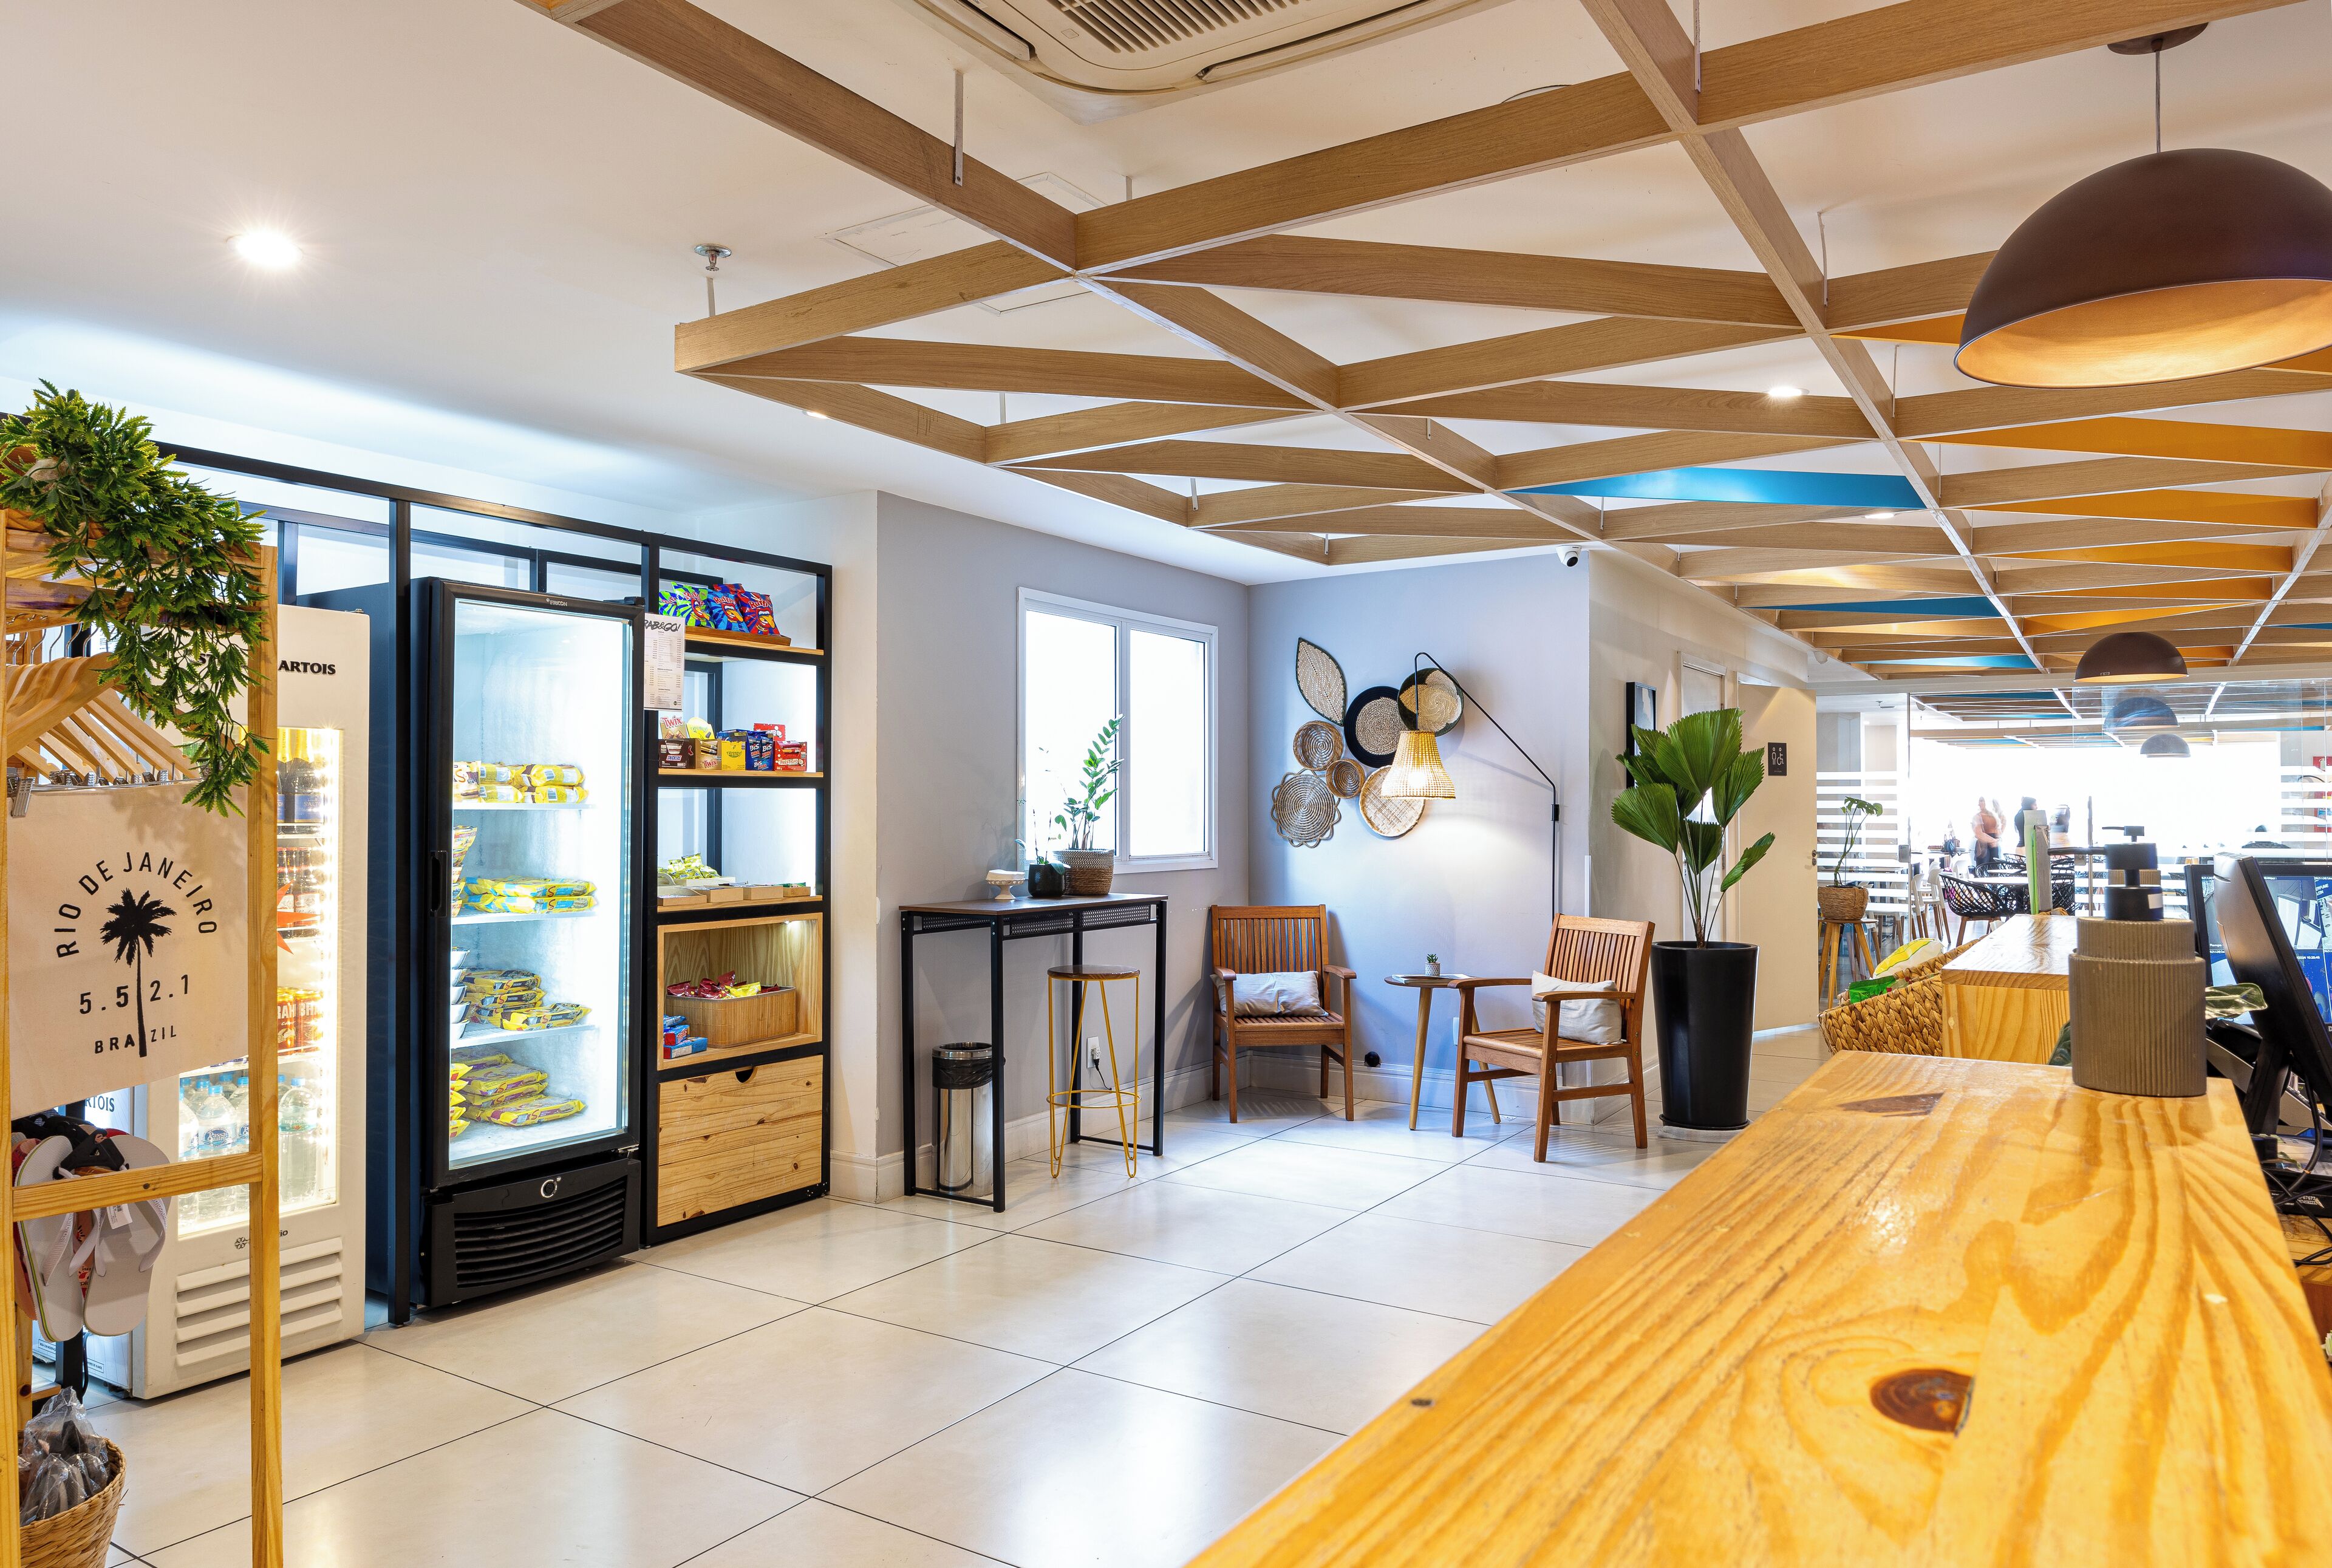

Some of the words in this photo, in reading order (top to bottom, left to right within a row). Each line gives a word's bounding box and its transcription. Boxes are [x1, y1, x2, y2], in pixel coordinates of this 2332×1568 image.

[644, 619, 681, 632] RAB&GO!
[278, 660, 336, 675] ARTOIS
[55, 904, 81, 958] RIO
[79, 861, 113, 895] DE
[123, 852, 217, 933] JANEIRO
[84, 1095, 115, 1113] RTOIS
